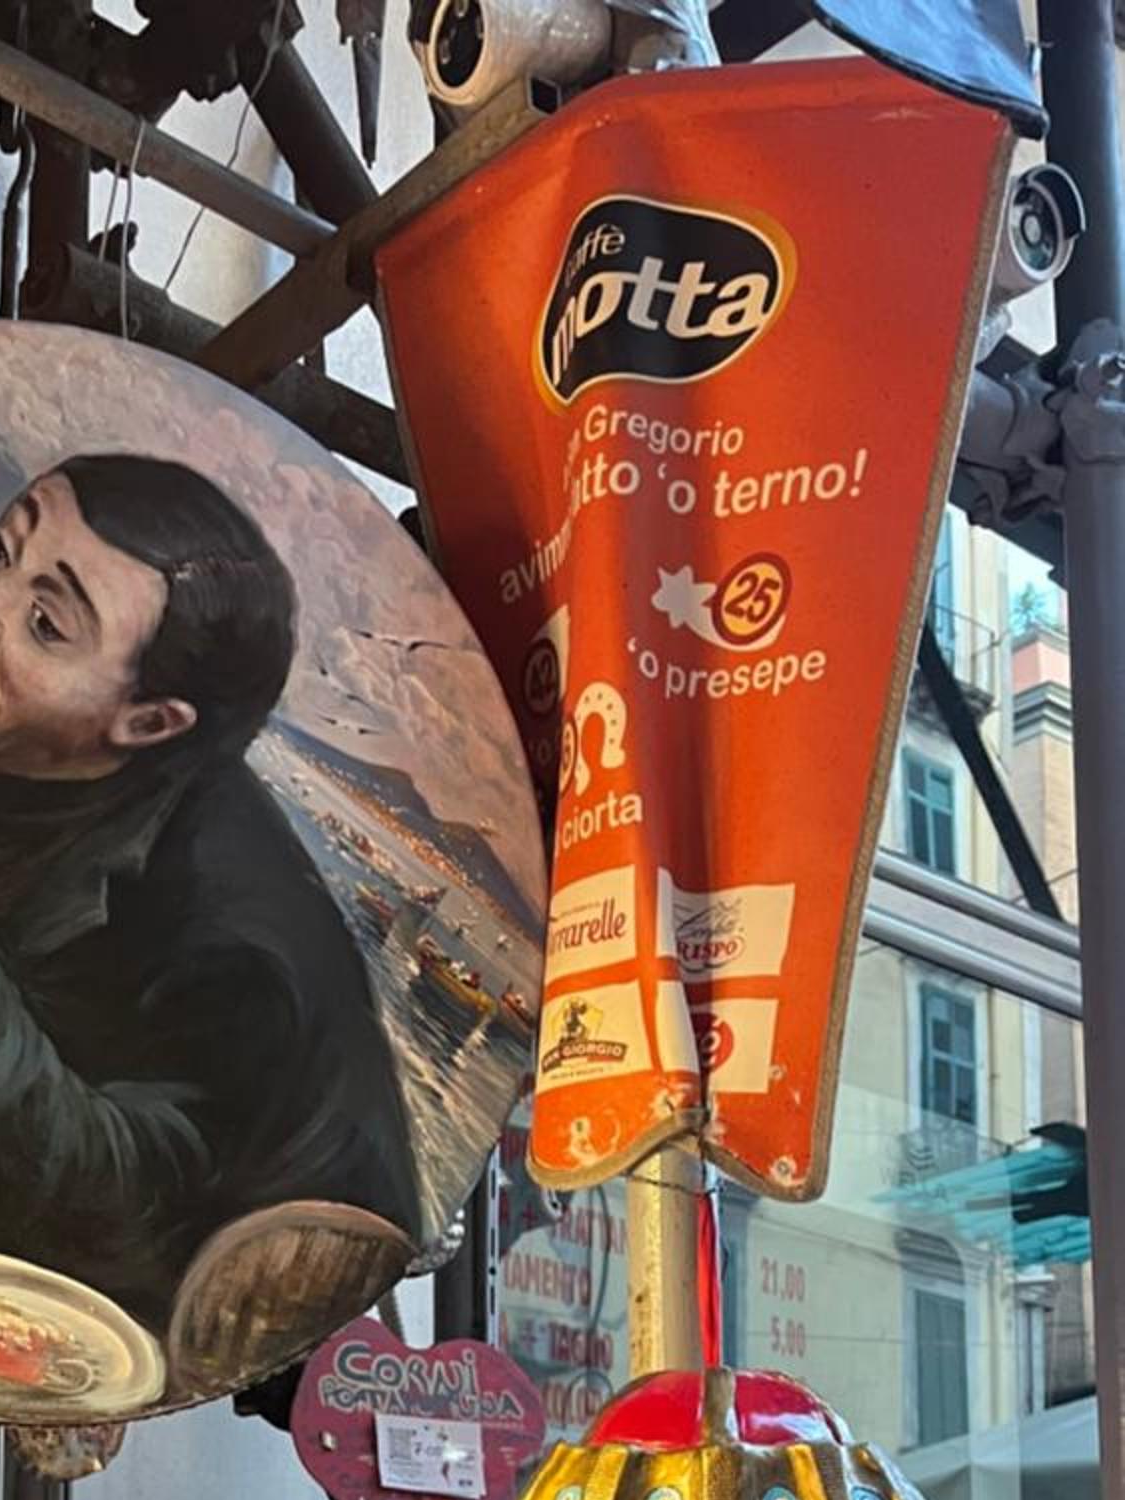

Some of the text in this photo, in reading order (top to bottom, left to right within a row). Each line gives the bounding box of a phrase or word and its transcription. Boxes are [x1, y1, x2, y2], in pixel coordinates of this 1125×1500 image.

[584, 404, 744, 456] Gregorio
[713, 449, 868, 518] terno!
[724, 570, 780, 622] 25
[665, 650, 827, 700] presepe
[562, 790, 644, 850] ciorta
[677, 939, 739, 963] RISPO
